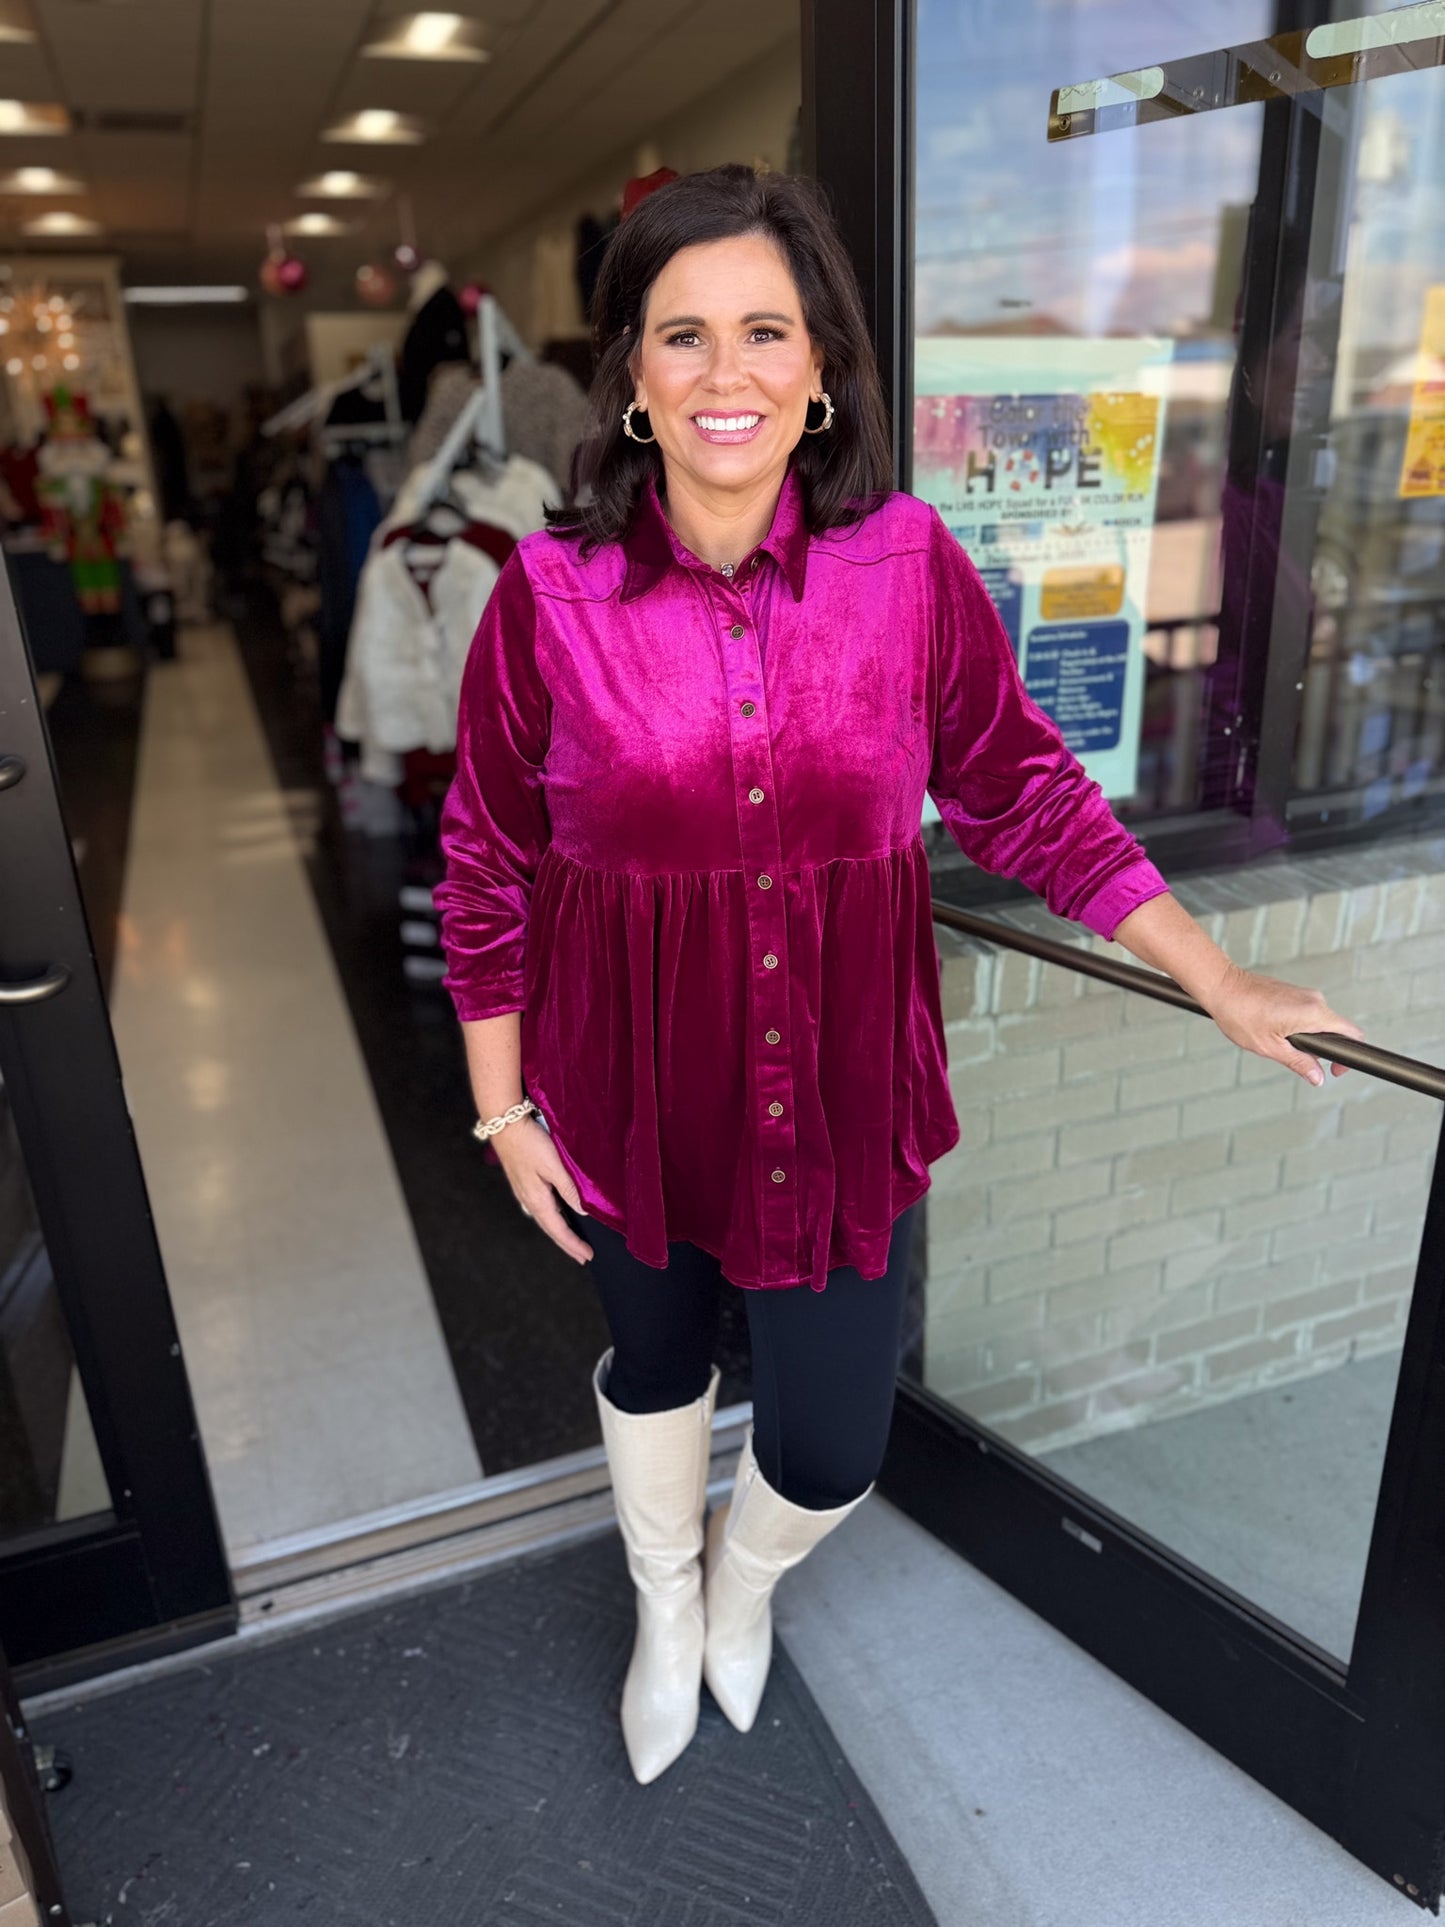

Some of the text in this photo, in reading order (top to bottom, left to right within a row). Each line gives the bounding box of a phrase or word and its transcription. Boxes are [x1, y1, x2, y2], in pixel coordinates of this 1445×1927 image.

[979, 425, 1090, 448] Town with
[966, 446, 1103, 494] HOPE
